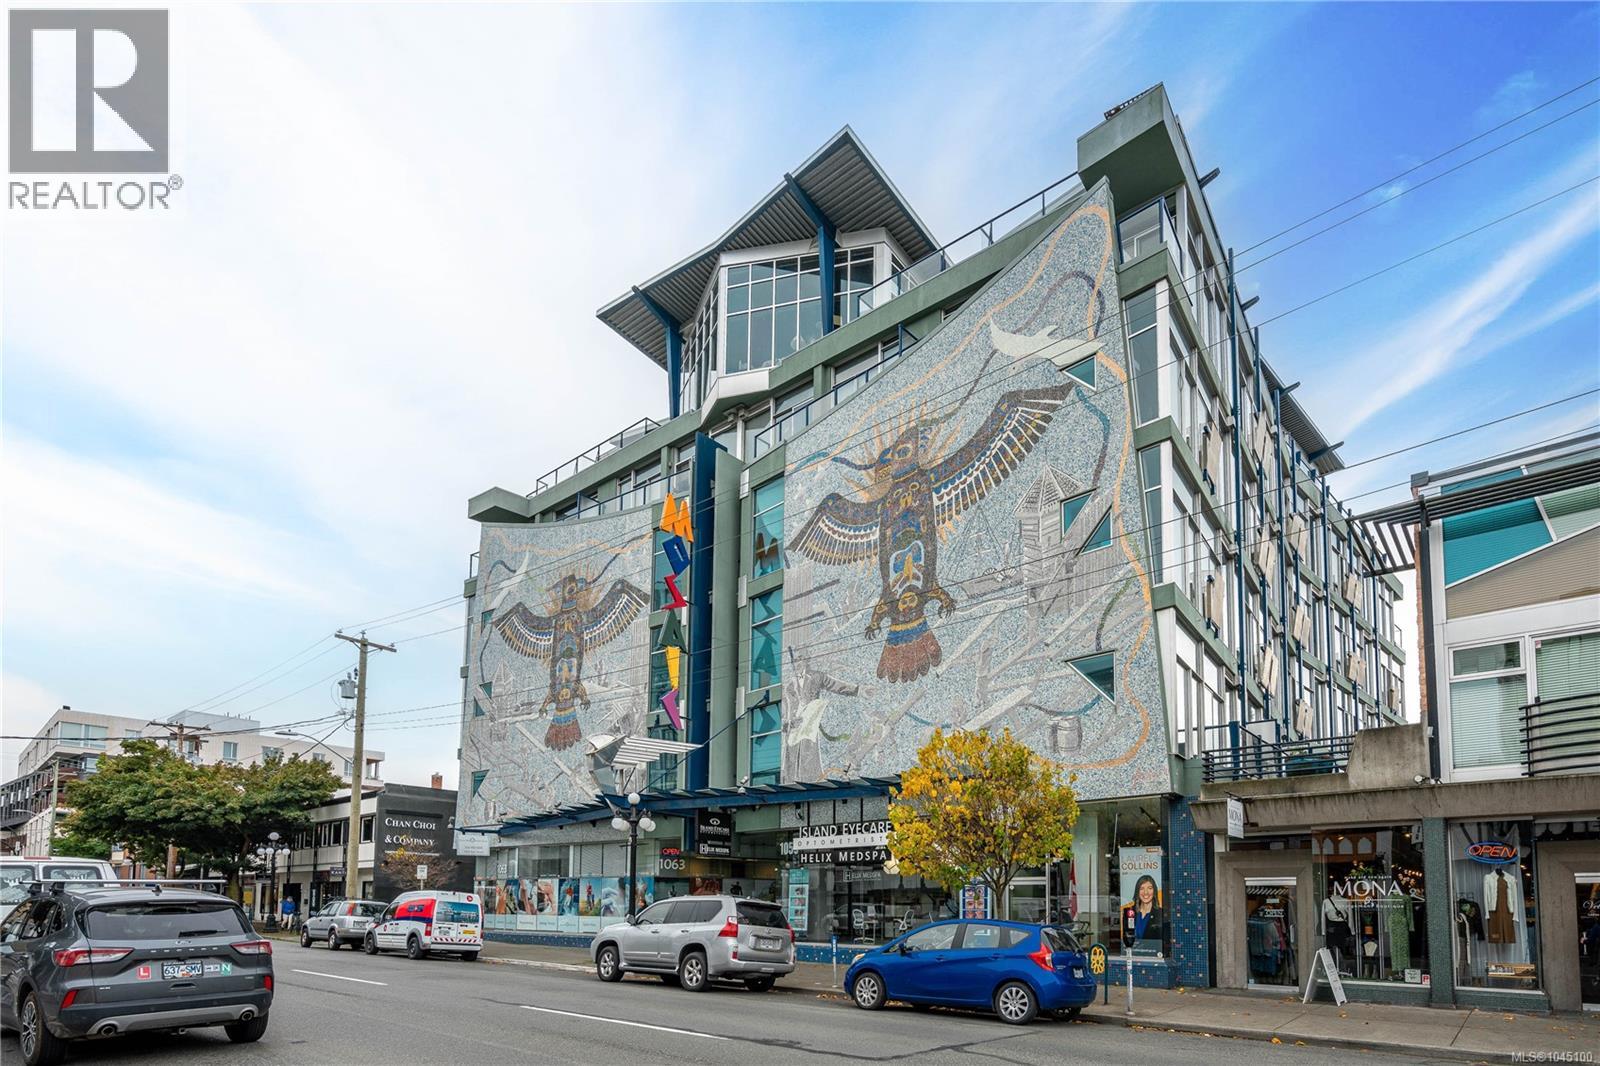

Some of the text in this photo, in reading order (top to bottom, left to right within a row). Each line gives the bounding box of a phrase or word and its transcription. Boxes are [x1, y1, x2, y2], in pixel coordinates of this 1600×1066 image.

[659, 492, 694, 731] MOSAIC
[385, 818, 436, 830] CHAN CHOI
[799, 821, 892, 838] ISLAND EYECARE
[393, 835, 435, 846] COMPANY
[662, 847, 680, 855] OPEN
[800, 850, 887, 863] HELIX MEDSPA
[1468, 845, 1518, 858] OPEN
[659, 858, 685, 870] 1063
[1121, 861, 1159, 871] COLLINS
[1333, 880, 1404, 896] MONA
[140, 967, 149, 976] L
